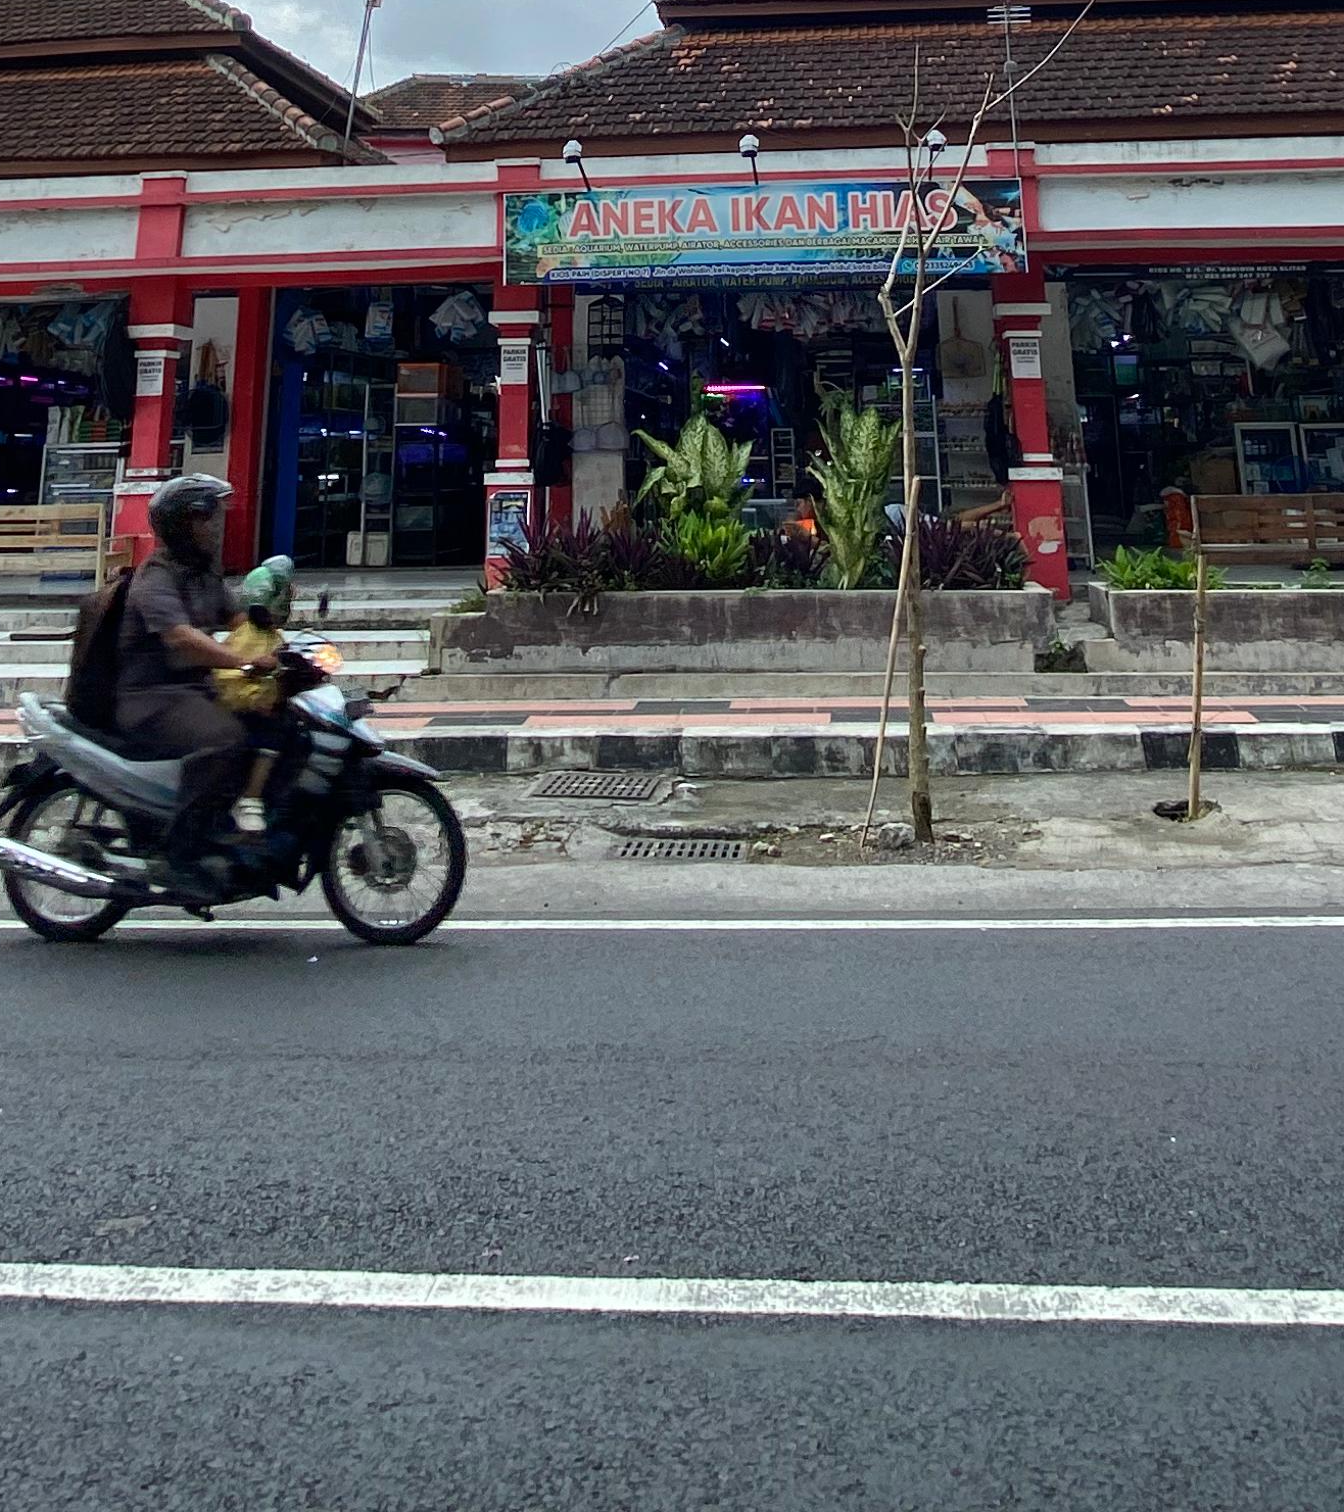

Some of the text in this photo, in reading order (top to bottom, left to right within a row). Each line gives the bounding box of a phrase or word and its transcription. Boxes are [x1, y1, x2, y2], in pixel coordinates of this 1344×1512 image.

[568, 191, 957, 238] ANEKA IKAN HIAS
[574, 243, 623, 255] AQUARIUM,
[682, 240, 722, 251] AIRATOR,
[724, 238, 783, 250] ACCESSORIES
[785, 237, 804, 247] DAN
[807, 236, 850, 247] BERBAGAI
[852, 235, 886, 246] MACAM
[1011, 348, 1038, 356] GRATIS
